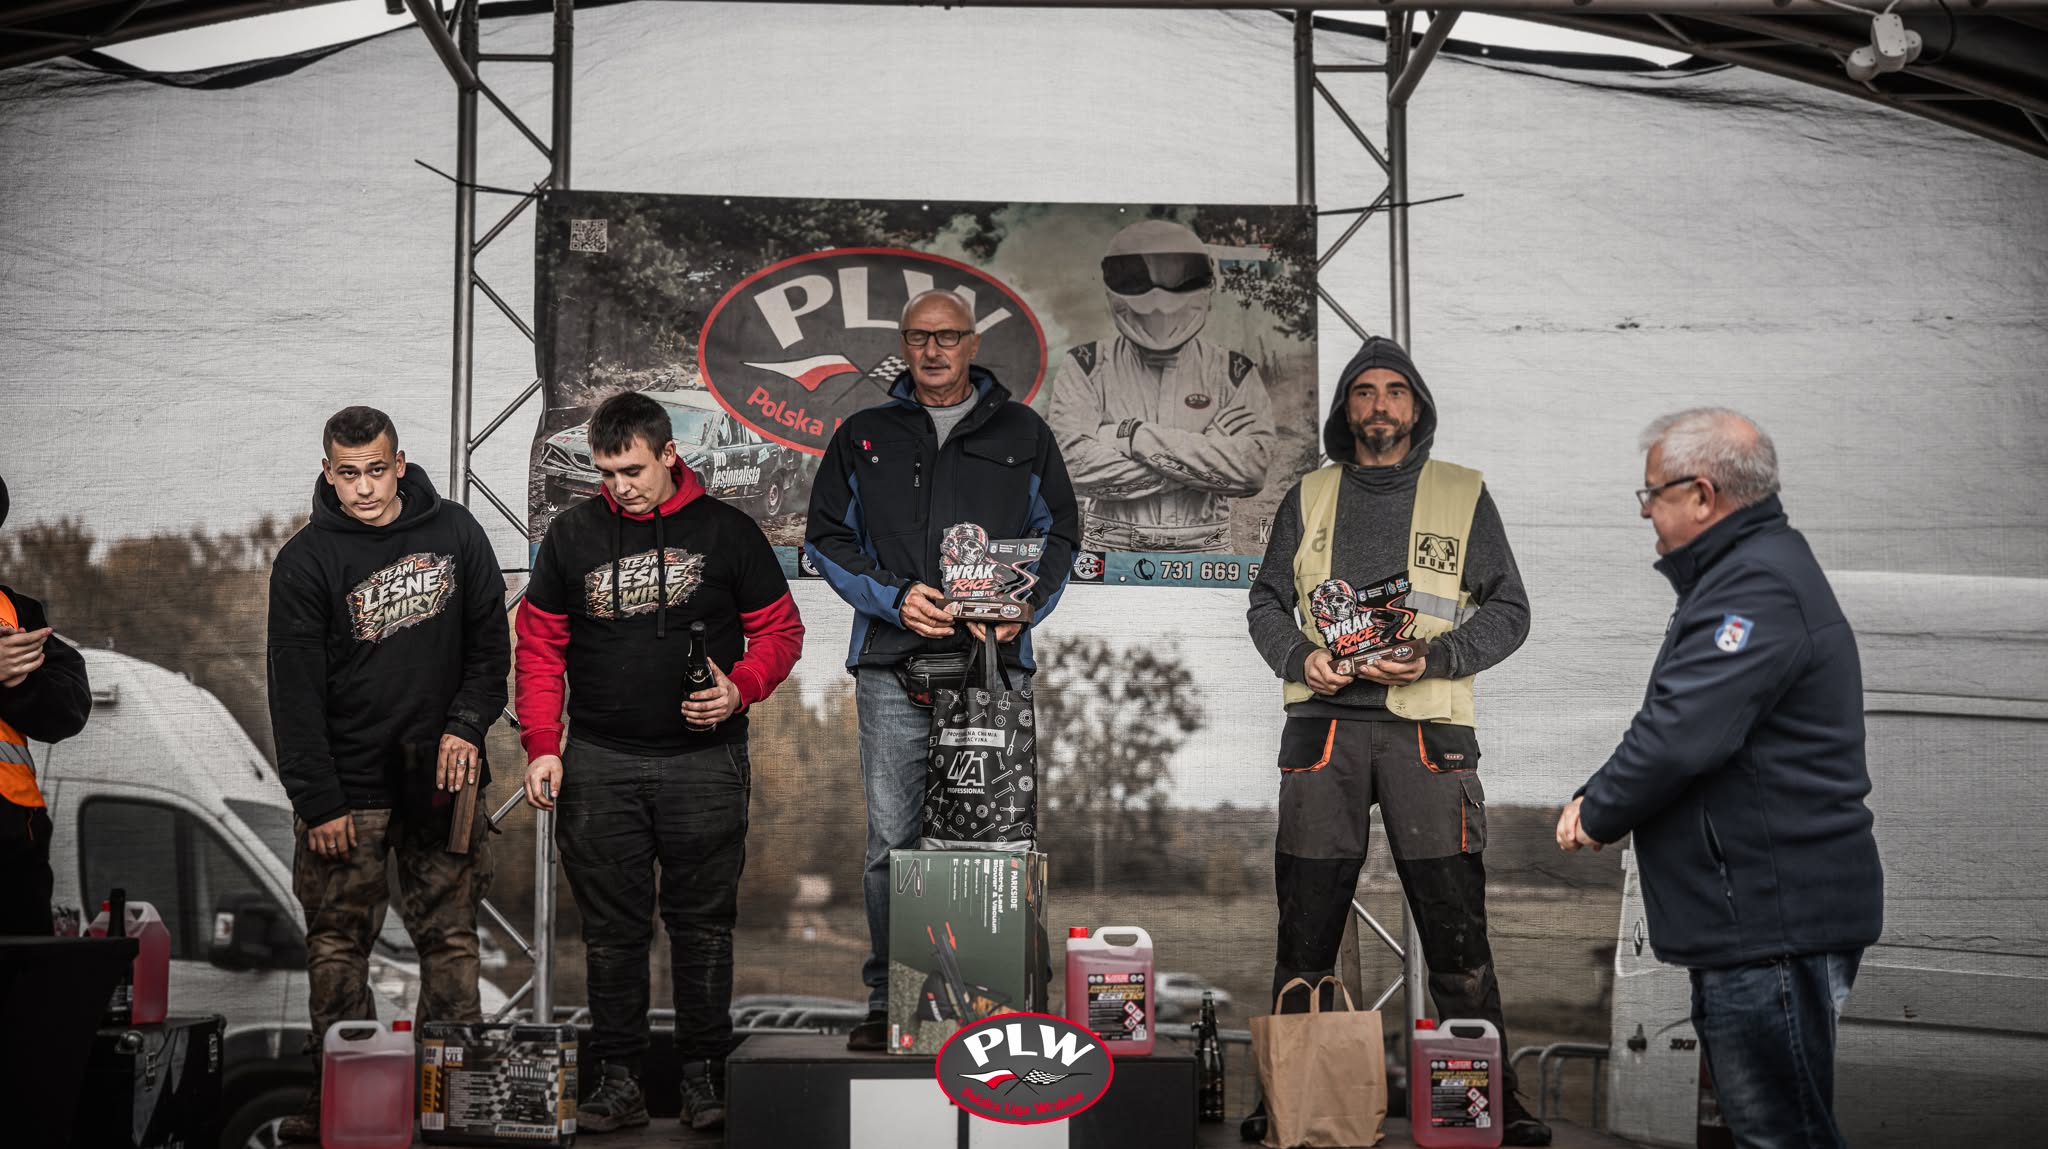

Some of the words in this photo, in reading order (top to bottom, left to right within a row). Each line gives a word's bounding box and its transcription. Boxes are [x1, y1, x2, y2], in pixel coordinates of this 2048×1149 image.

[746, 385, 824, 437] Polska
[380, 561, 414, 583] TEAM
[943, 563, 997, 582] WRAK
[1161, 561, 1193, 580] 731
[1200, 562, 1240, 581] 669
[1418, 556, 1456, 571] HUNT
[950, 579, 994, 593] RACE
[1320, 611, 1374, 644] WRAK
[1334, 625, 1378, 653] RACE
[1010, 870, 1018, 910] PARKSIDE
